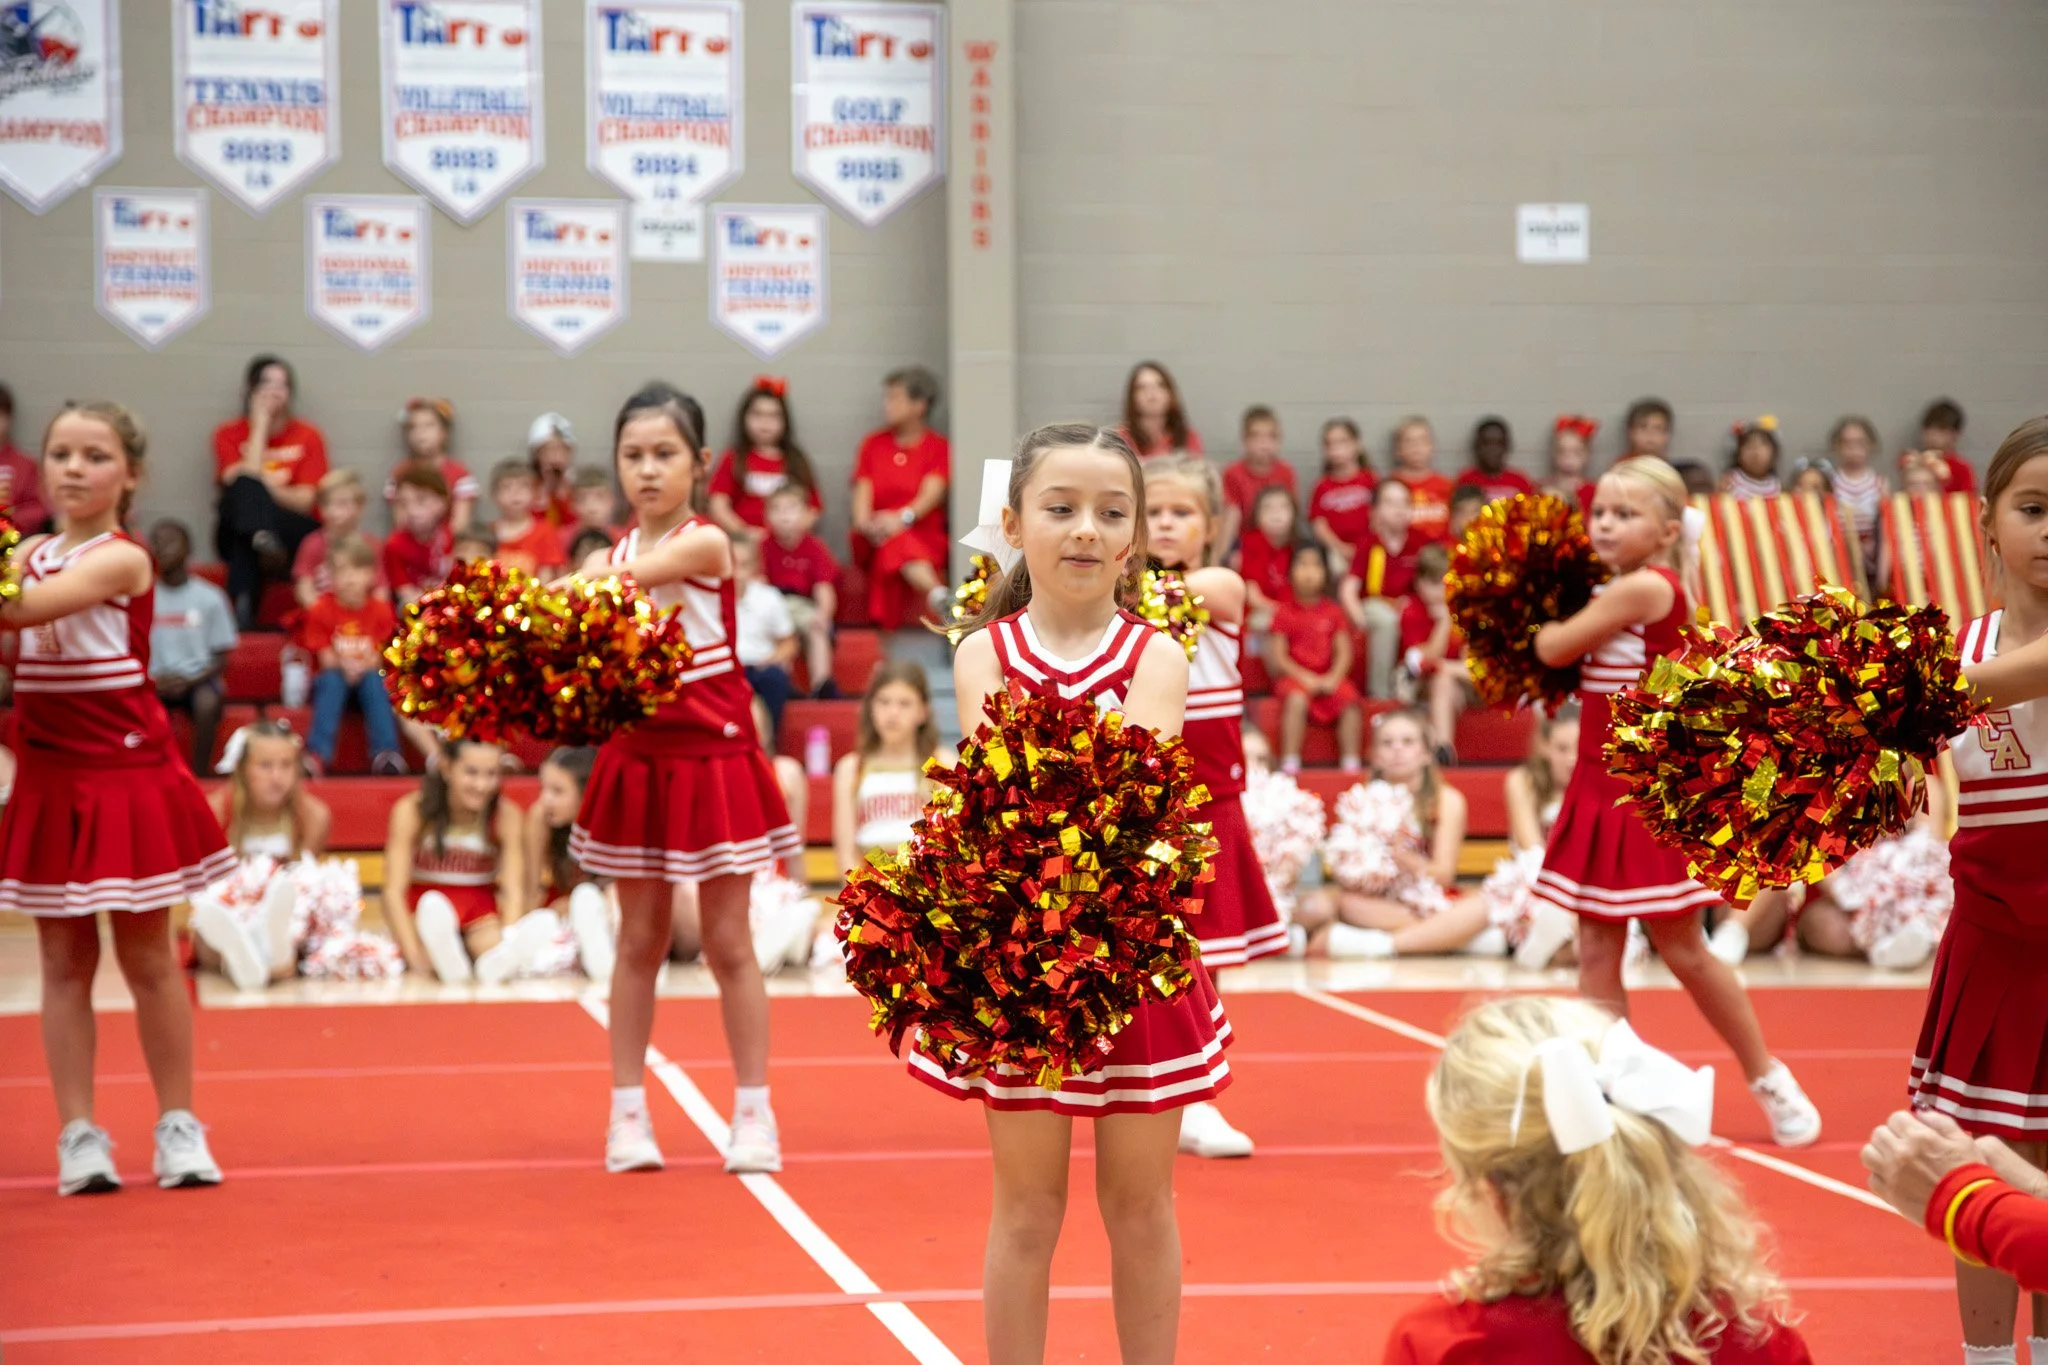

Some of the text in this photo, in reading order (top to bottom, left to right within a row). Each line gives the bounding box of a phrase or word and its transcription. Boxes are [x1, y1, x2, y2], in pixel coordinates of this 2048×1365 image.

[187, 78, 326, 107] TENNIS
[396, 86, 528, 114] VOLLEYBALL
[600, 93, 729, 120] VOLLEYBALL
[187, 105, 325, 134] CHAMPION
[834, 99, 908, 124] GOLF
[395, 113, 531, 140] CHAMPION
[599, 120, 729, 147] CHAMPION
[806, 125, 934, 153] CHAMPION
[963, 41, 998, 250] WARRIORS
